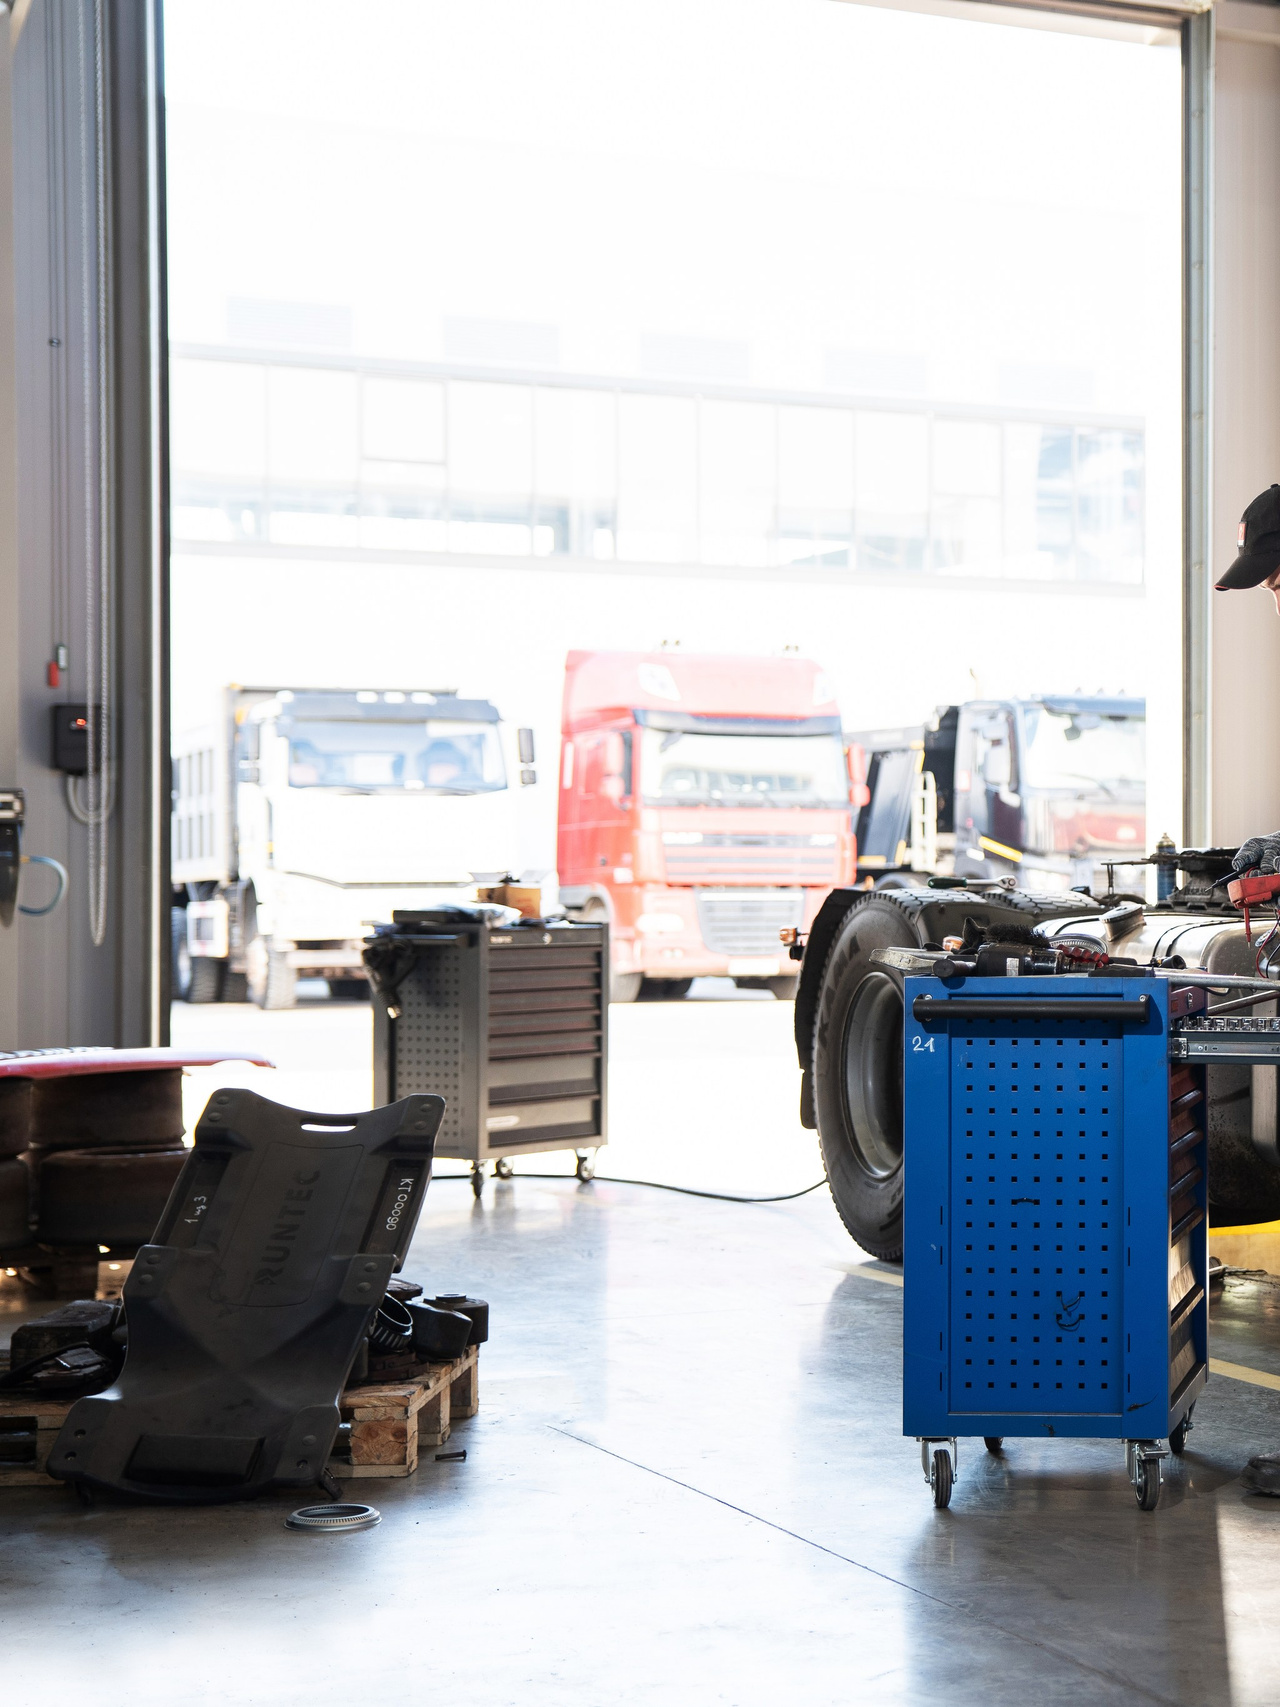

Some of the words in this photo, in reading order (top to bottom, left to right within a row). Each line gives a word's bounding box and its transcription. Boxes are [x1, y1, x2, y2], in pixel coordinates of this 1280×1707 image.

[912, 1035, 935, 1052] 21
[193, 1195, 207, 1204] 3
[254, 1169, 320, 1285] RUNTEC
